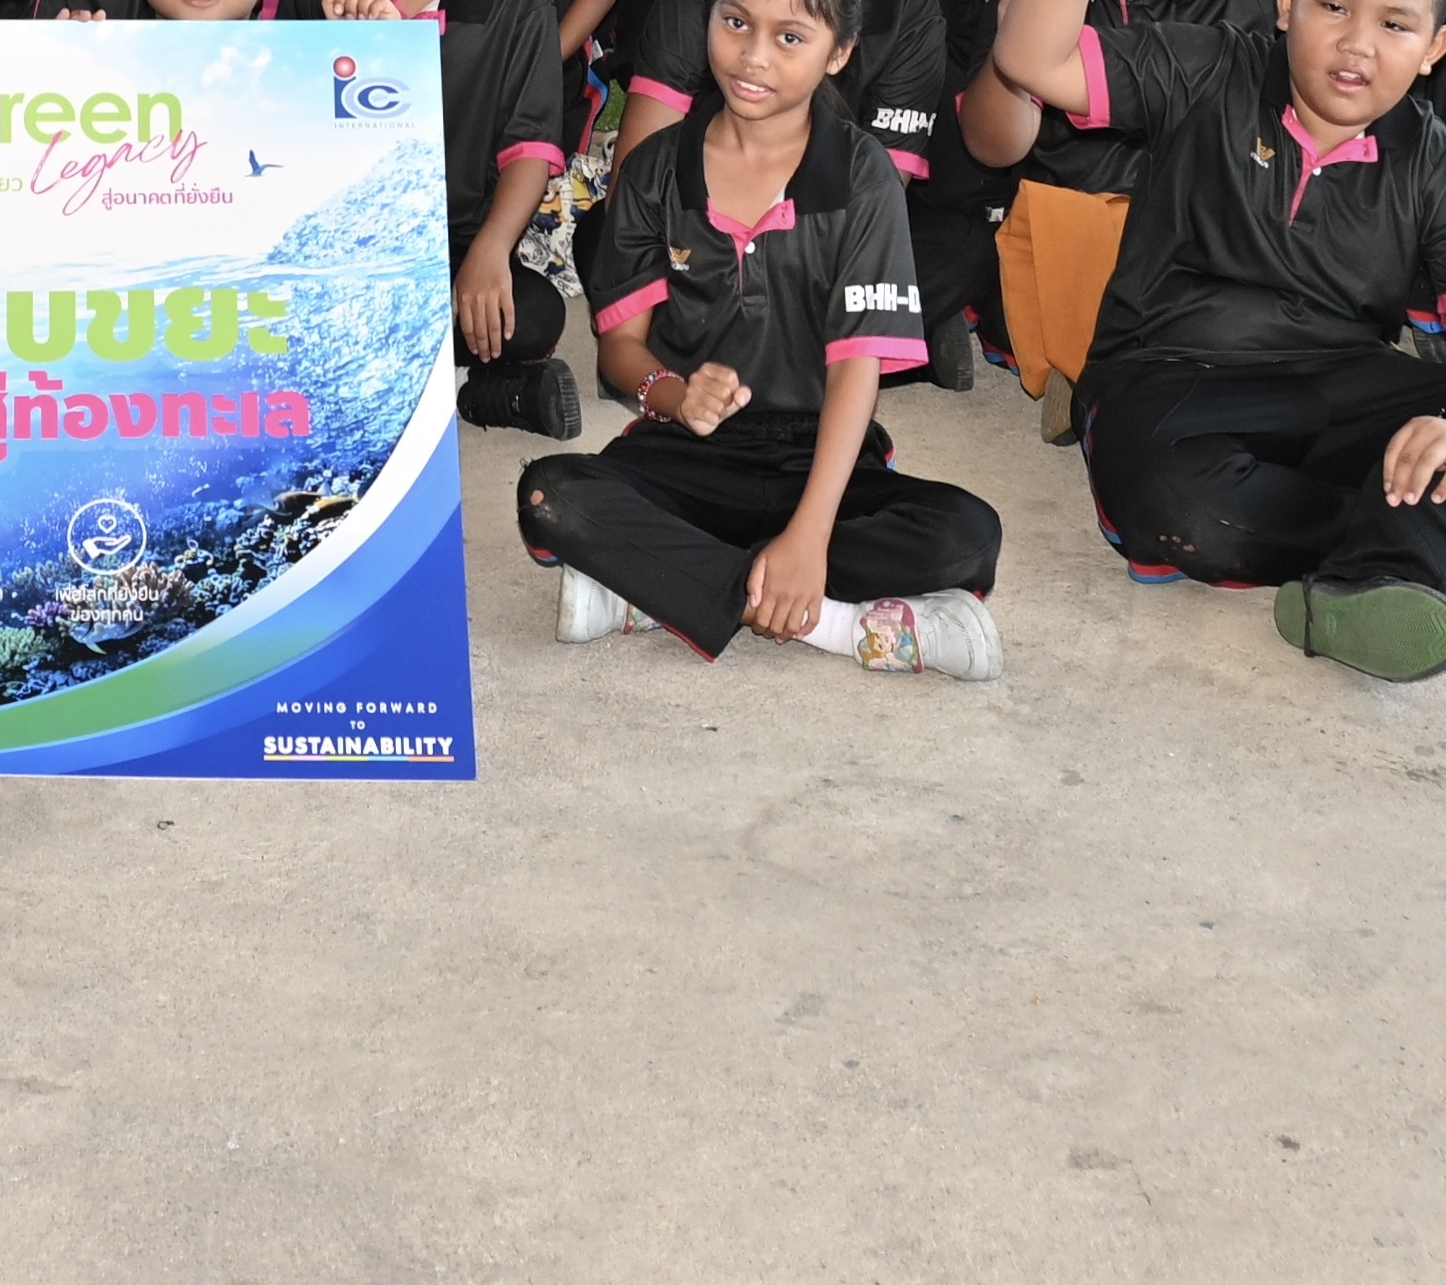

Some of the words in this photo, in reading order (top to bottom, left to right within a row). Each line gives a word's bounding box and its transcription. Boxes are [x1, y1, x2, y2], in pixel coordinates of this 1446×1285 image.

[30, 128, 209, 217] Legacy
[101, 182, 234, 211] สู่อนาคตที่ยั่งยืน
[276, 702, 348, 714] MOVING
[356, 702, 438, 714] FORWARD
[350, 720, 366, 730] TO
[263, 736, 453, 755] SUSTAINABILITY
